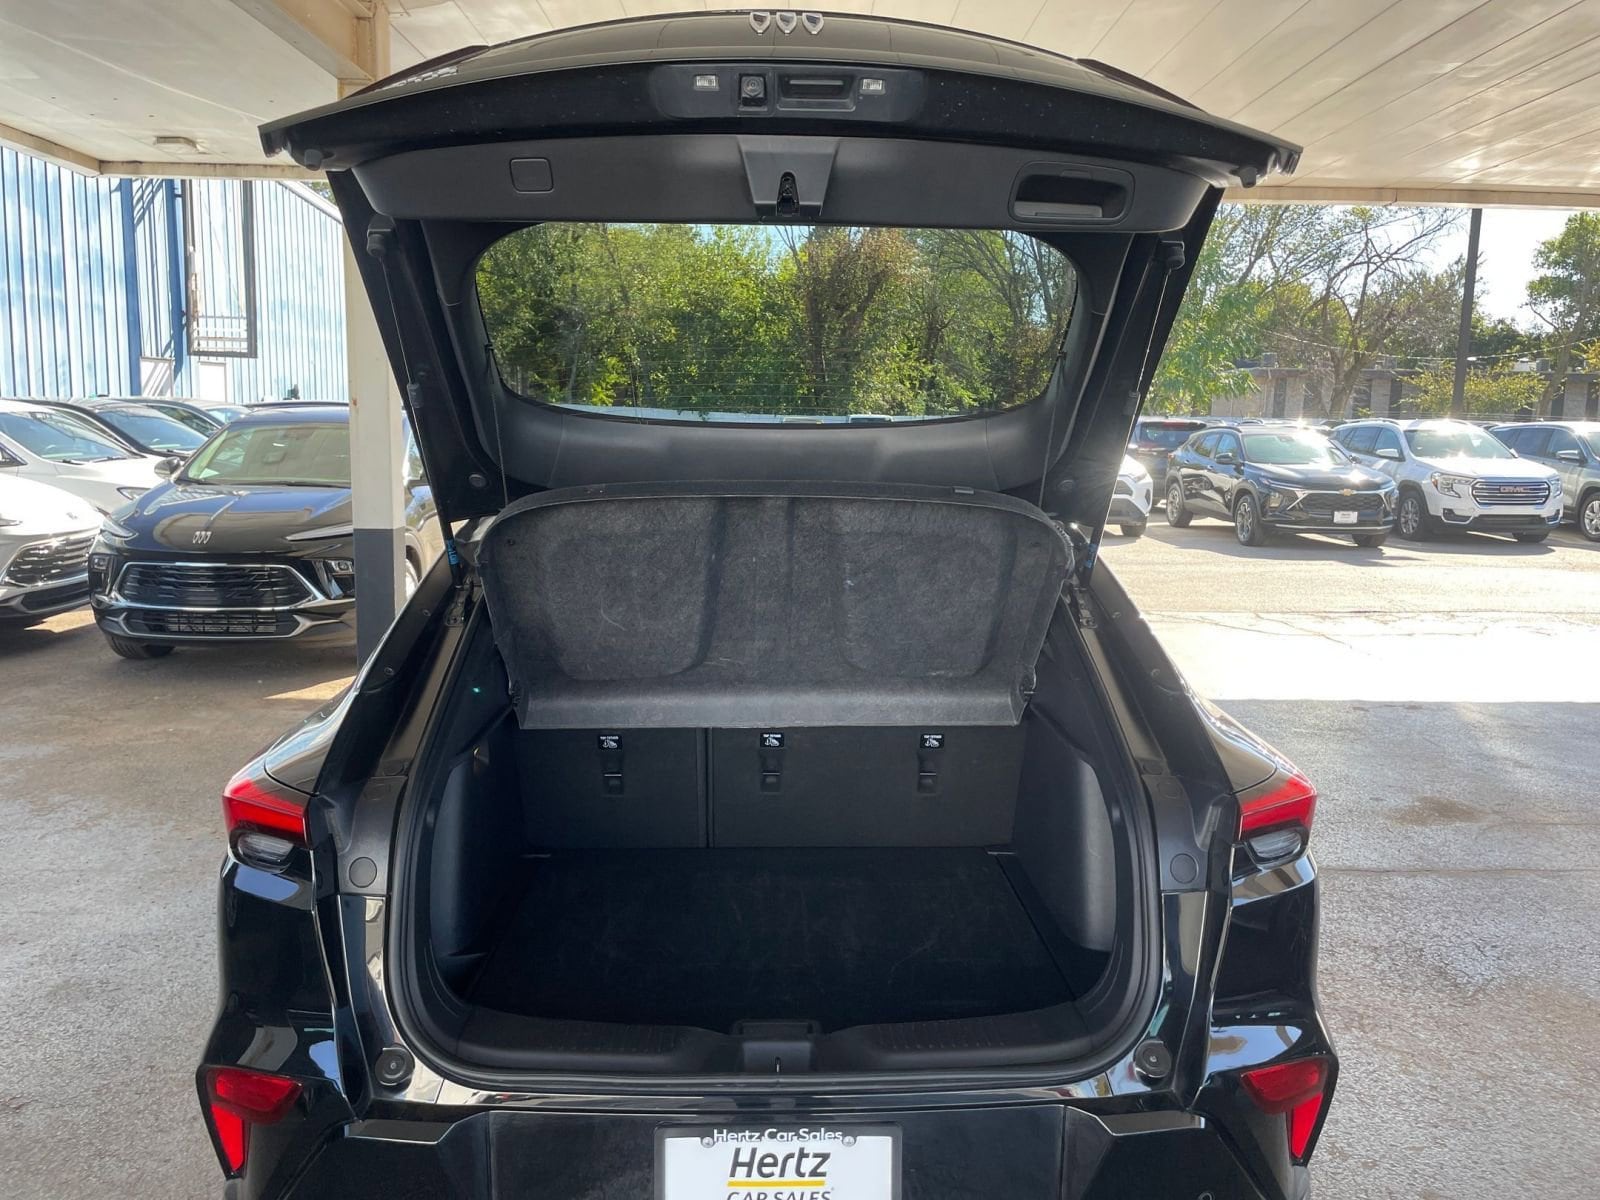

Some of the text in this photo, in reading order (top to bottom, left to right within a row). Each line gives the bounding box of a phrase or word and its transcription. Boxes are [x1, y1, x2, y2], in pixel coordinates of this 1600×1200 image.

[713, 1128, 843, 1142] Hertz Car Sales
[729, 1147, 831, 1178] Hertz
